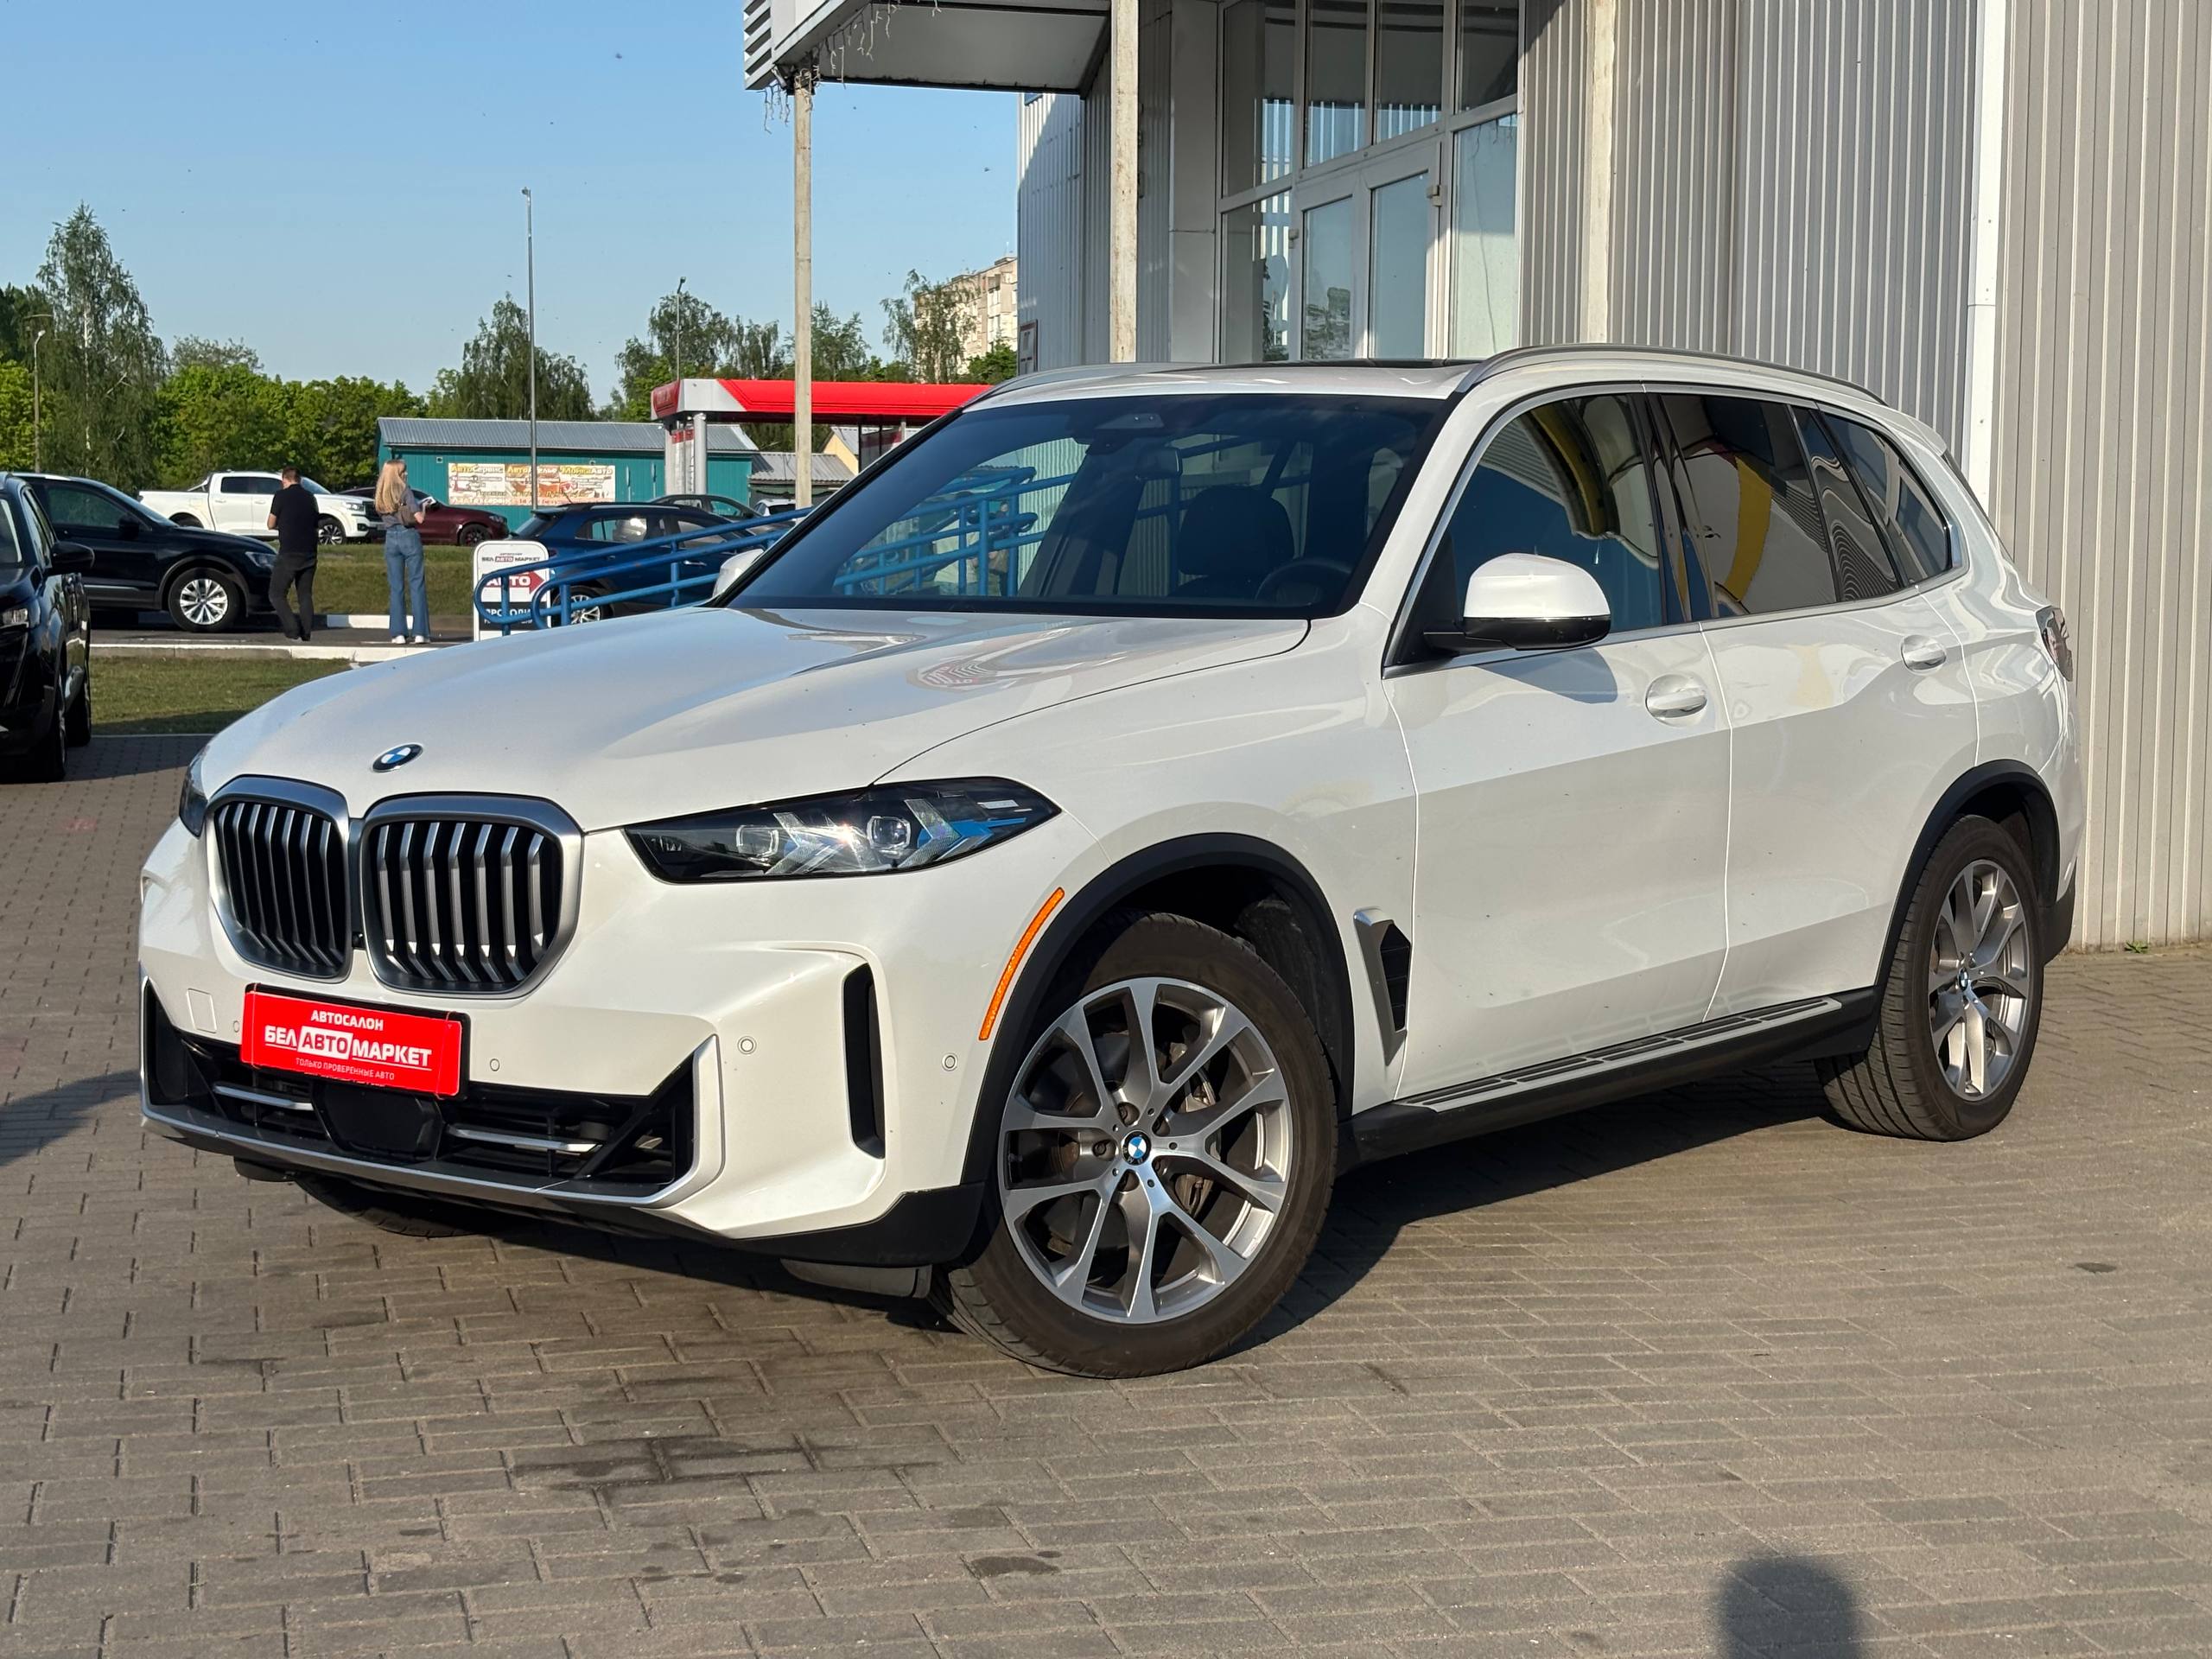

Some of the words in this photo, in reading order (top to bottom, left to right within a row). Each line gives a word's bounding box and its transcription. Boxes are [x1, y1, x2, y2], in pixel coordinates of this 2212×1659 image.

[486, 575, 531, 587] АТО
[311, 1010, 384, 1031] АВТОСАЛОН
[296, 1058, 323, 1069] ТОЛЬКО
[323, 1062, 374, 1077] ПРОВЕРЕННЫЕ
[375, 1071, 395, 1080] АВТО
